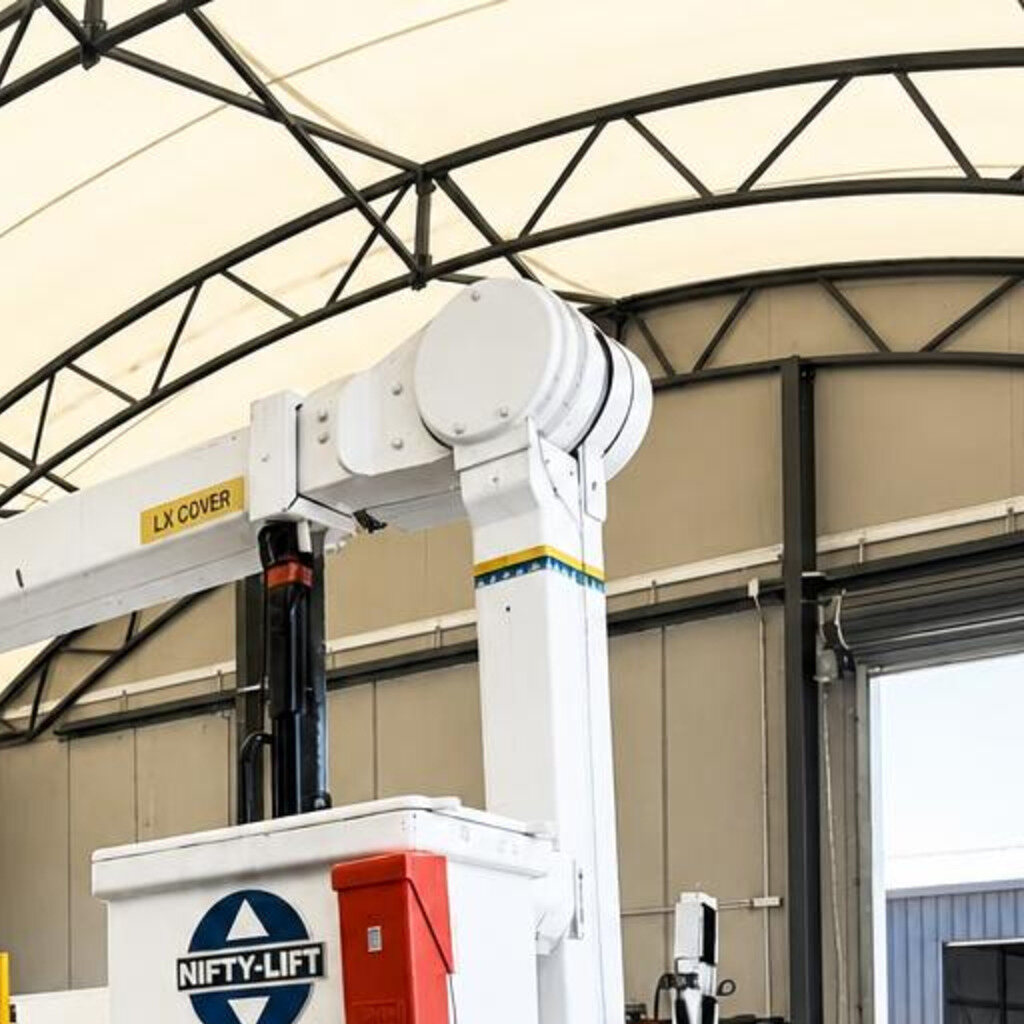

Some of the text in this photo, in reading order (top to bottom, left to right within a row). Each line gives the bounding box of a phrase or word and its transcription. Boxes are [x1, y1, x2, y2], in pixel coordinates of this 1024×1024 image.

[153, 489, 231, 533] LX COVER
[179, 947, 321, 987] NIFTY-LIFT
